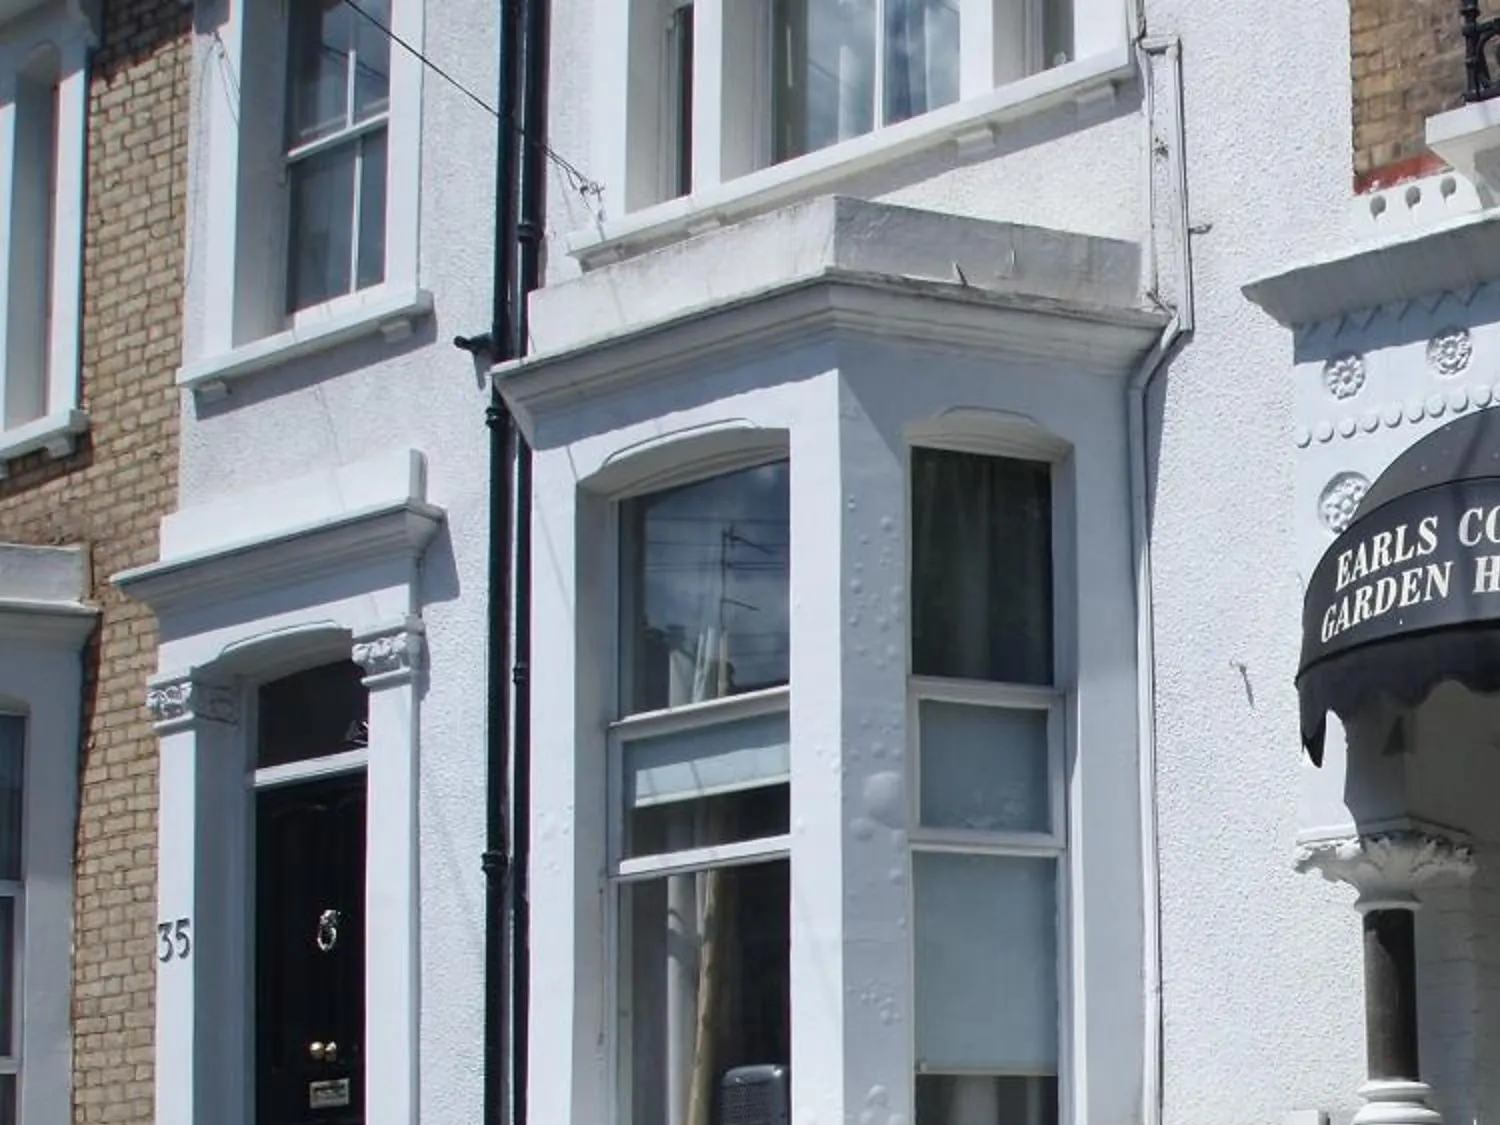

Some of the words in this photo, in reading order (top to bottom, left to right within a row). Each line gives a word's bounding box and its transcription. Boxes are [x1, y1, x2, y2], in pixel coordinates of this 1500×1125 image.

[1335, 515, 1439, 593] EARLS
[1321, 560, 1454, 643] GARDEN
[158, 918, 190, 962] 35
